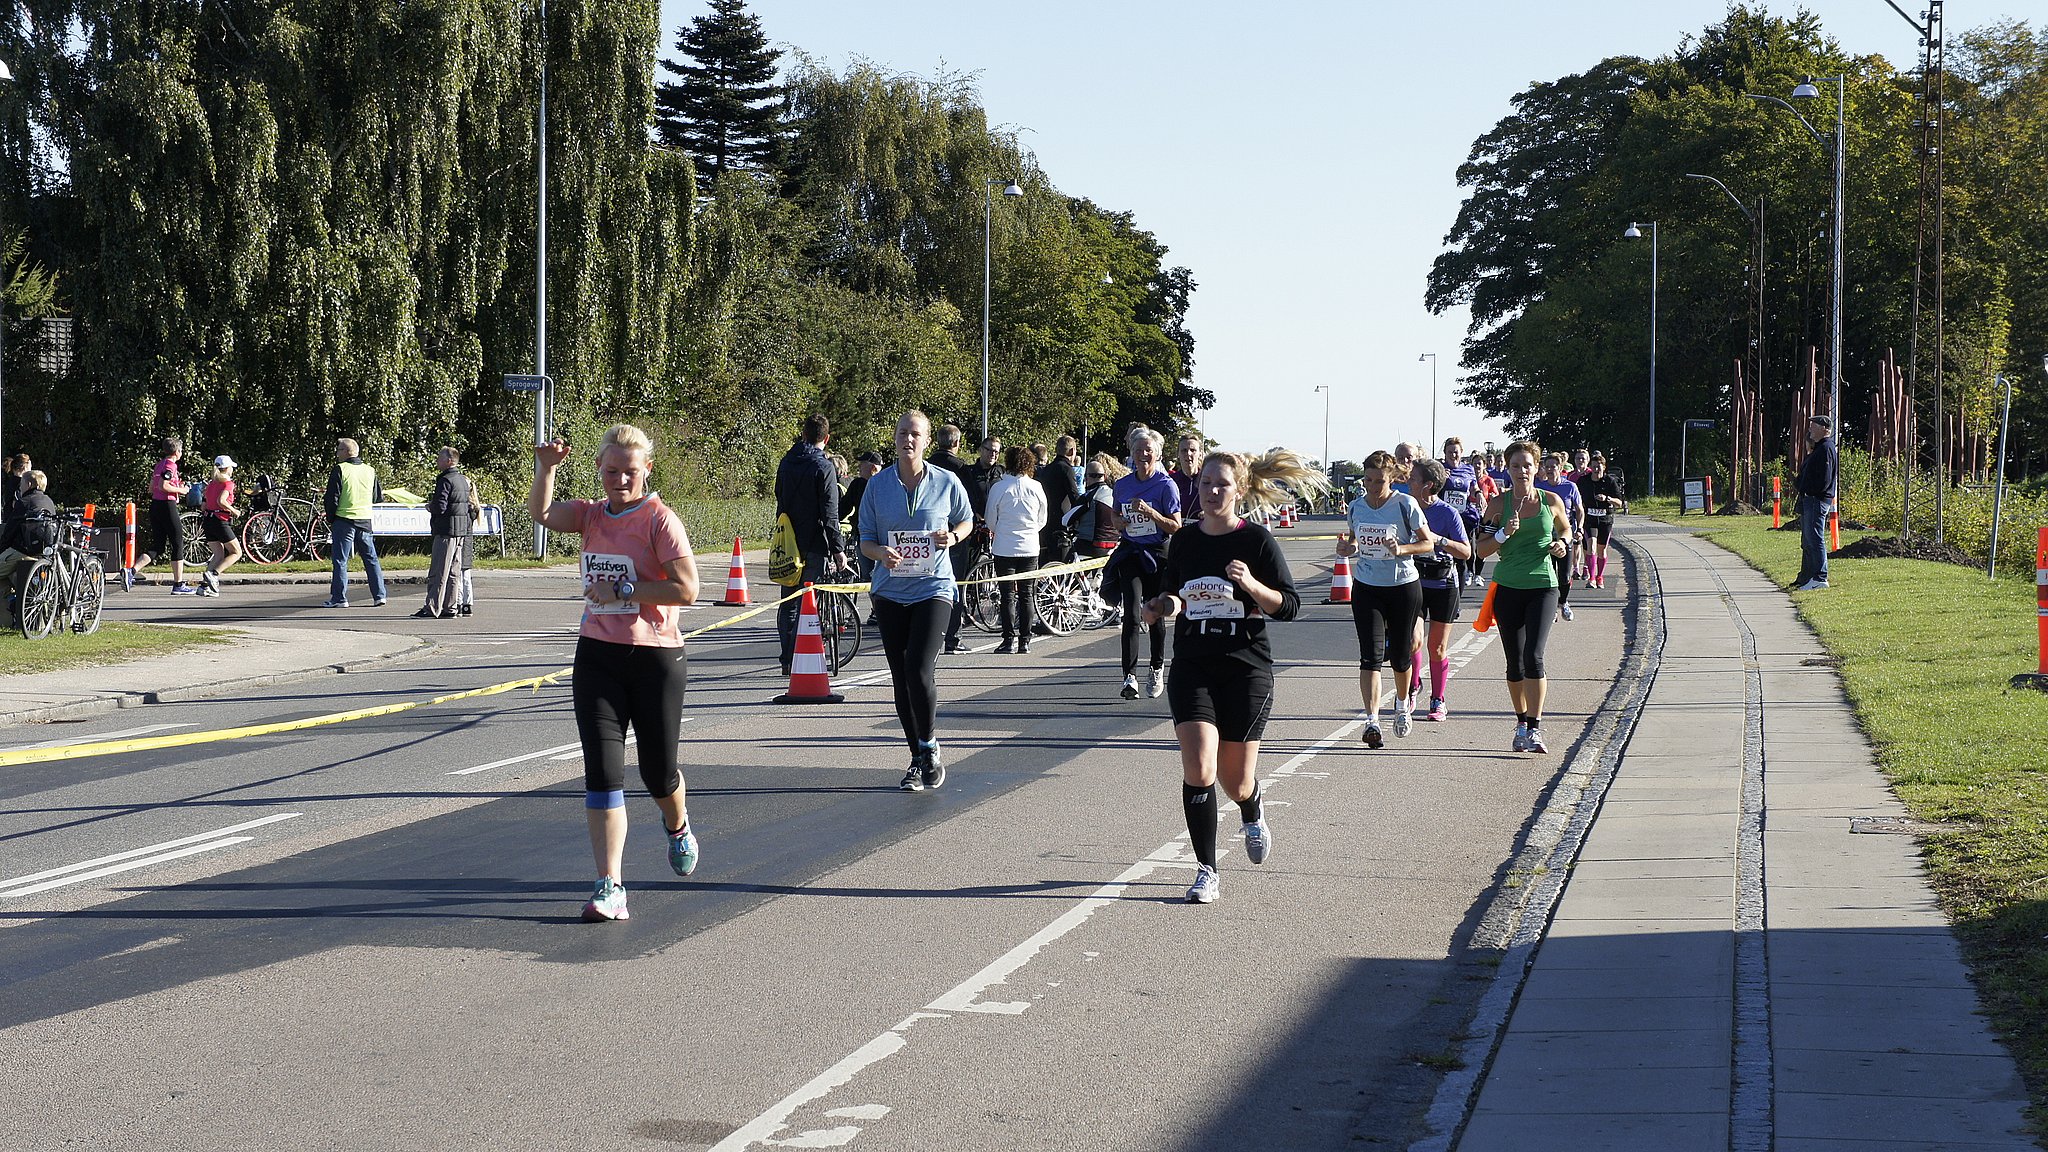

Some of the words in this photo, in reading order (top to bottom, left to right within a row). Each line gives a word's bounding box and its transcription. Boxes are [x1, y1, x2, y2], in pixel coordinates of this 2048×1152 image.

[373, 513, 429, 528] Marienly
[1359, 525, 1387, 534] Faaborg
[893, 532, 930, 546] Vestfyen
[894, 546, 930, 559] 3283
[585, 555, 628, 574] Vestfyen
